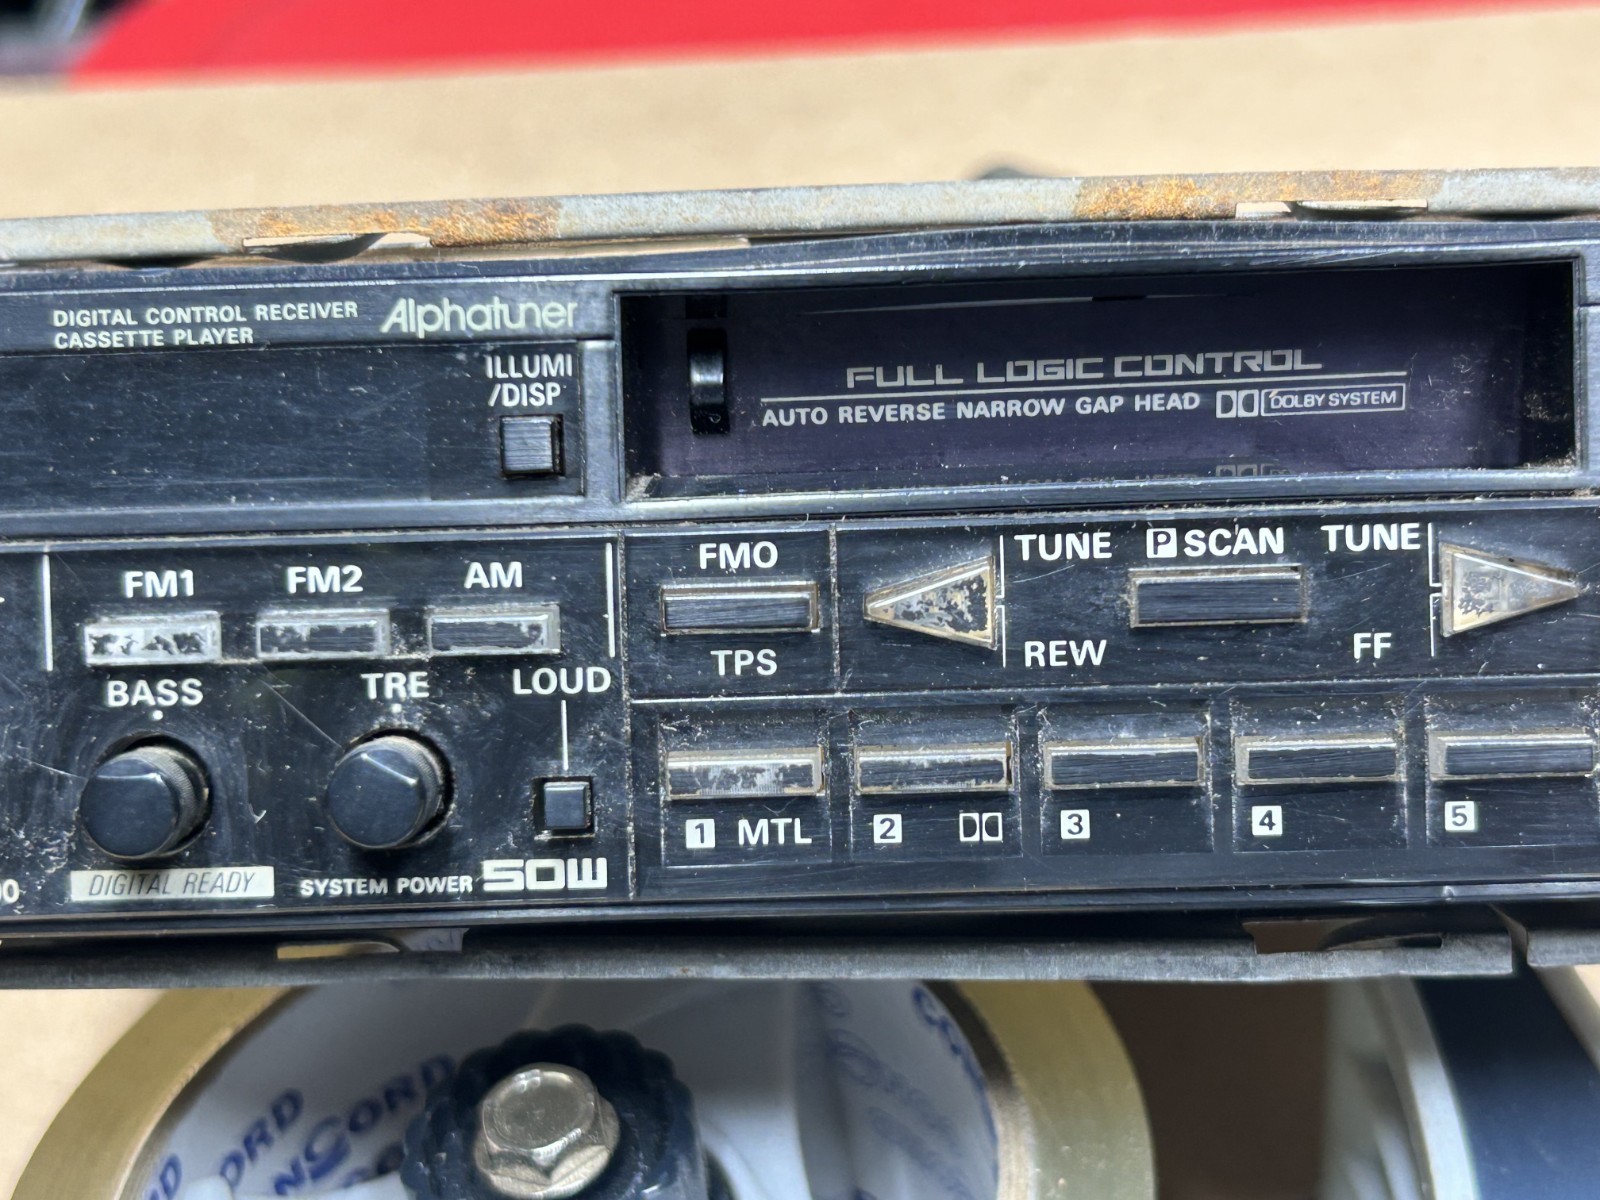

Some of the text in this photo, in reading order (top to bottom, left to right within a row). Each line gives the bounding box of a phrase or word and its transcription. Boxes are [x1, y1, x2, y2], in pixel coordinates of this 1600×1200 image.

[52, 300, 359, 327] DIGITAL CONTROL RECEIVER
[380, 297, 578, 340] Alphatuner
[53, 326, 255, 349] CASSETTE PLAYER
[485, 354, 573, 379] ILLUMI
[846, 348, 1323, 389] FULL LOGIC CONTROL
[488, 382, 561, 408] /DISP
[762, 392, 1201, 427] AUTO REVERSE NARROW GAP HEAD
[1269, 390, 1398, 410] DOLBY SYSTEM
[1014, 532, 1113, 561] TUNE
[1152, 527, 1286, 557] P SCAN
[1320, 522, 1422, 552] TUNE
[123, 570, 195, 597] FM1
[286, 565, 364, 593] FM2
[463, 561, 524, 590] AM
[1023, 640, 1108, 668] REW
[1353, 632, 1392, 660] FF
[710, 648, 778, 676] TPS
[106, 678, 204, 708] BASS
[361, 671, 430, 701] TRE
[512, 667, 612, 696] LOUD
[737, 817, 813, 846] MTL
[88, 868, 257, 897] DIGITAL READY
[300, 857, 608, 896] SYSTEM POWER 50W
